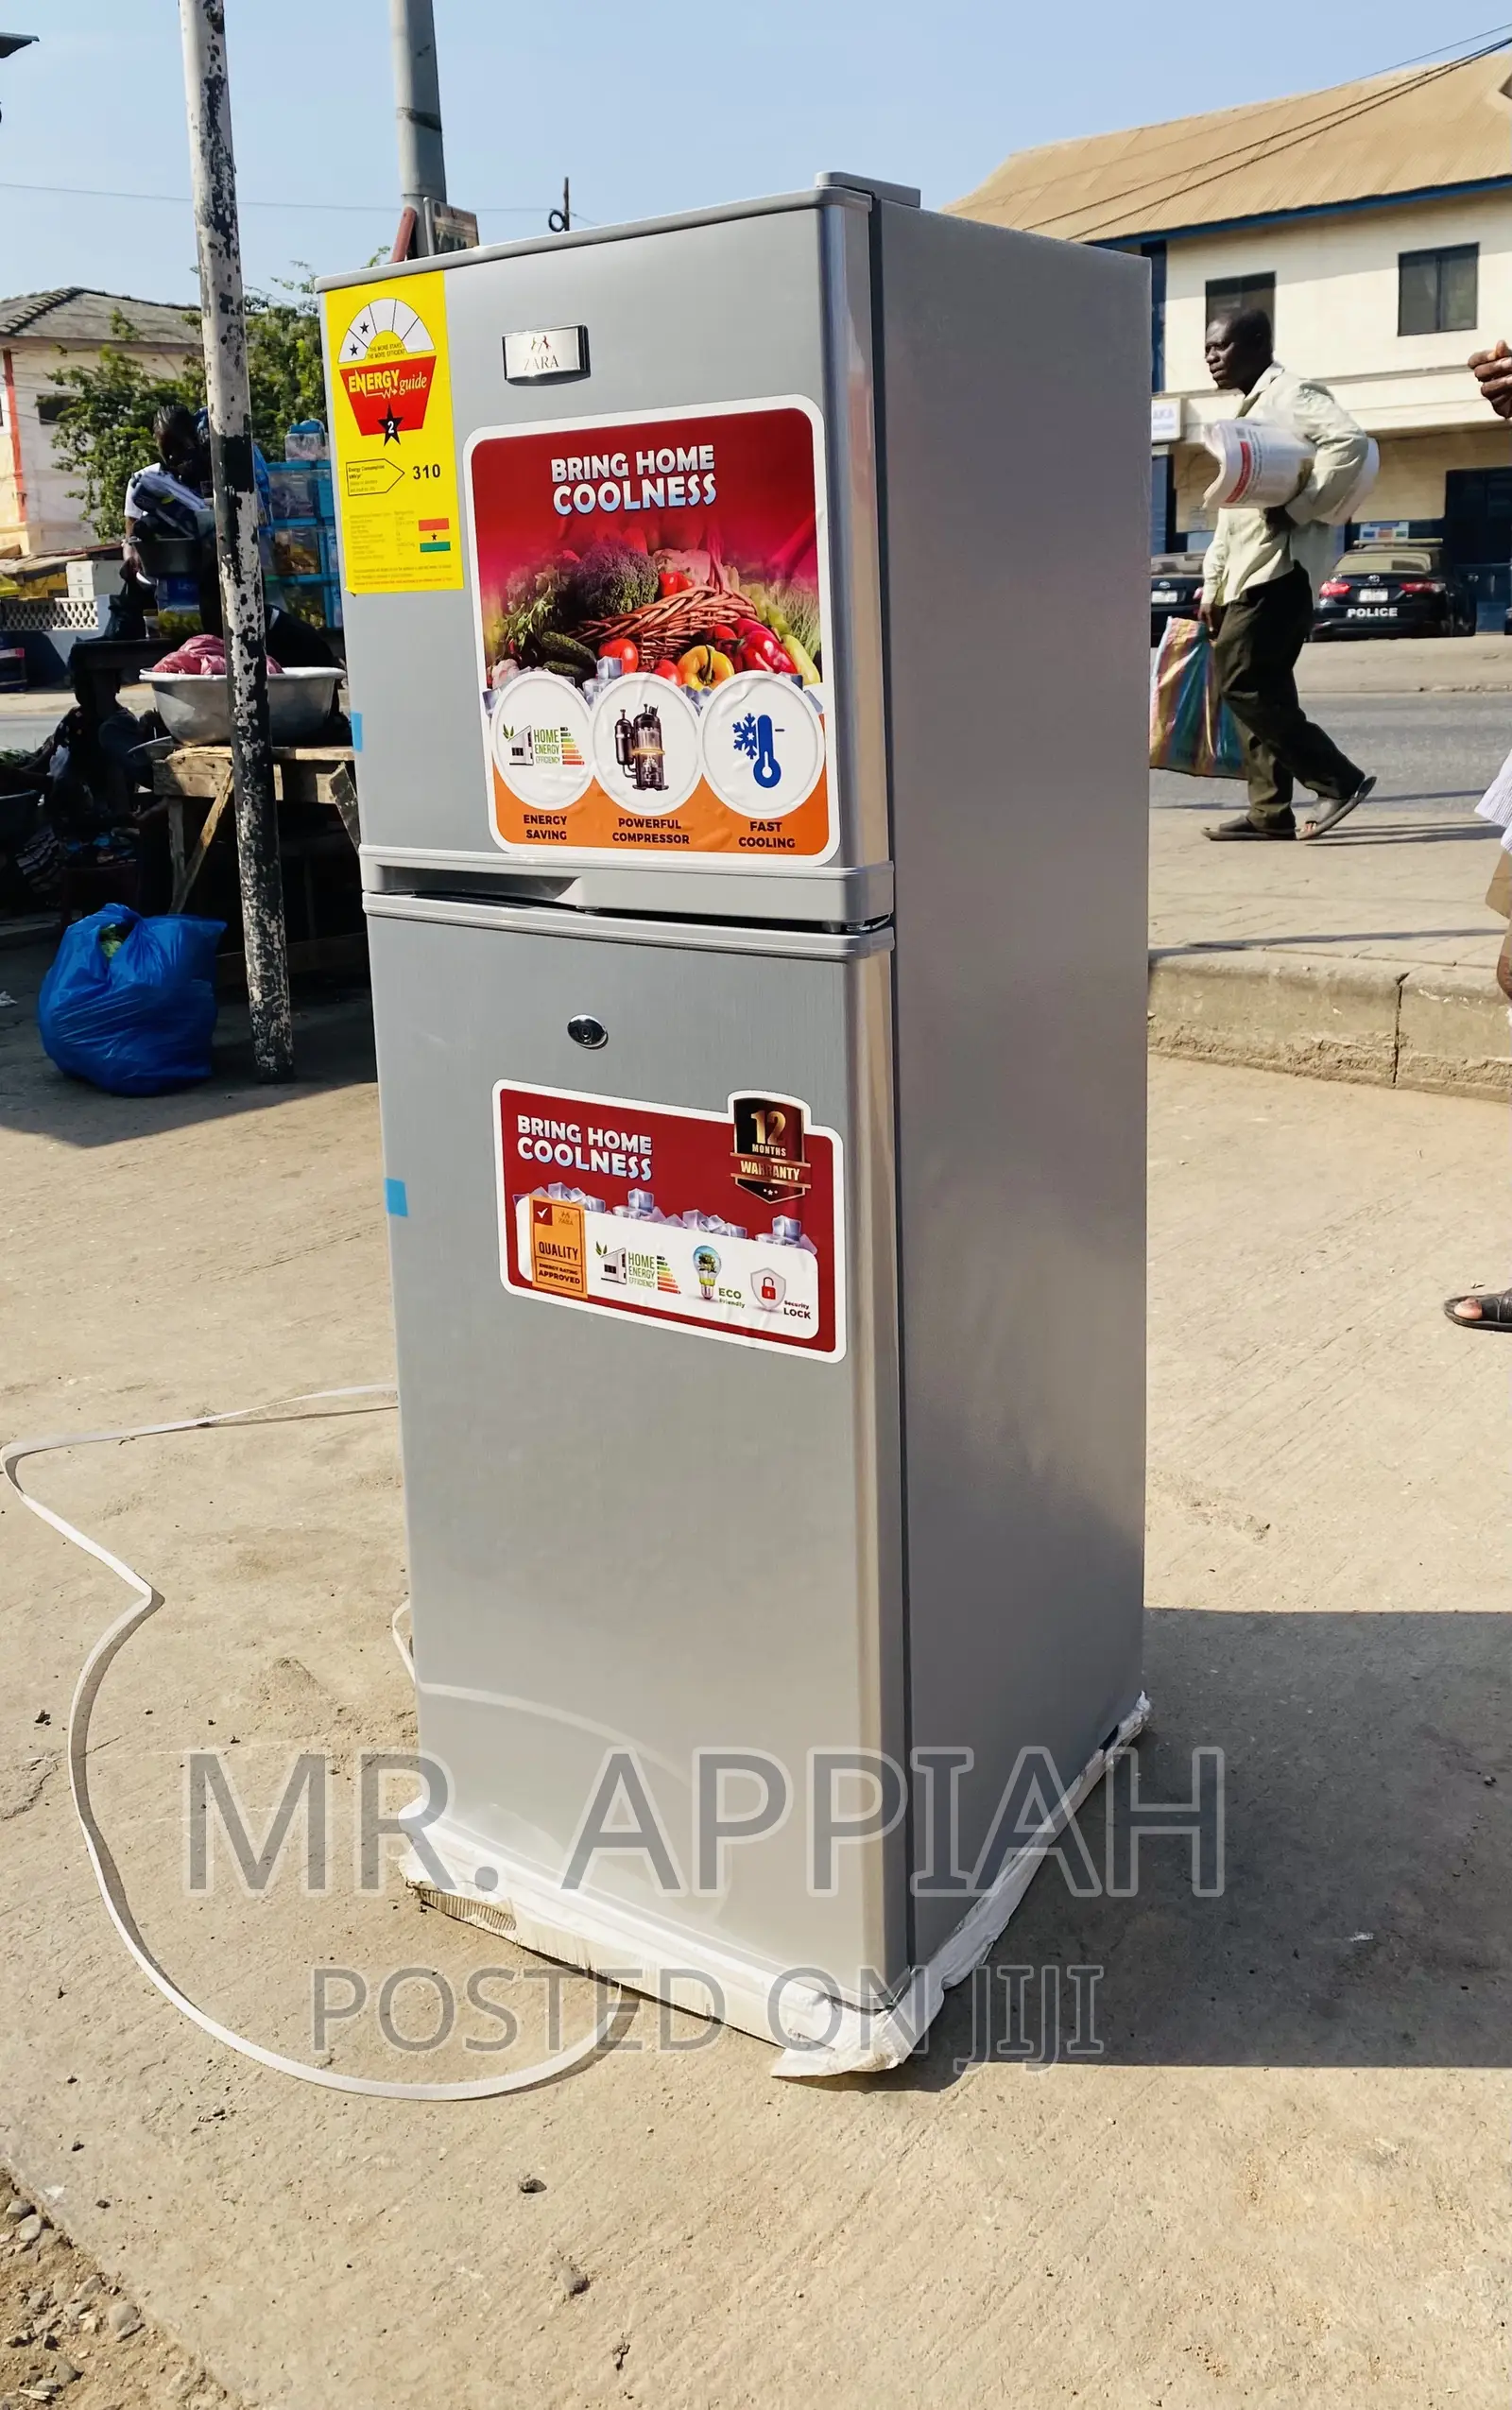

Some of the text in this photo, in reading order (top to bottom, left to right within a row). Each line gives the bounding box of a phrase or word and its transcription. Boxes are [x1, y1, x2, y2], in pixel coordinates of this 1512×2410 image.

[524, 354, 559, 370] ZARA
[349, 370, 427, 395] ENERGY guide
[387, 421, 395, 433] 2
[551, 445, 715, 483] BRING HOME
[413, 464, 440, 480] 310
[553, 473, 717, 516] COOLNESS
[1347, 607, 1398, 618] POLICE
[533, 729, 559, 743] HOME
[535, 744, 559, 755] ENERGY
[536, 755, 560, 765] EFFICIENCY
[524, 814, 567, 825] ENERGY
[618, 818, 681, 830] POWERFUL
[749, 821, 782, 833] FAST
[526, 829, 567, 840] SAVING
[612, 832, 690, 844] COMPRESSOR
[739, 836, 796, 849] COOLING
[750, 1110, 786, 1145] 12
[517, 1114, 652, 1156] BRING HOME
[751, 1144, 786, 1156] MONTHS
[517, 1137, 652, 1181] COOLNESS
[740, 1161, 800, 1180] WARRANTY
[538, 1241, 578, 1261] QUALITY
[628, 1252, 655, 1269] HOME
[539, 1263, 558, 1271] ENERGY
[628, 1266, 655, 1280] ENERGY
[538, 1270, 580, 1284] APPROVED
[628, 1277, 656, 1289] EFFICIENCY
[718, 1288, 742, 1300] ECO
[719, 1298, 746, 1309] Friendly
[783, 1300, 810, 1310] Security
[783, 1308, 812, 1319] LOCK
